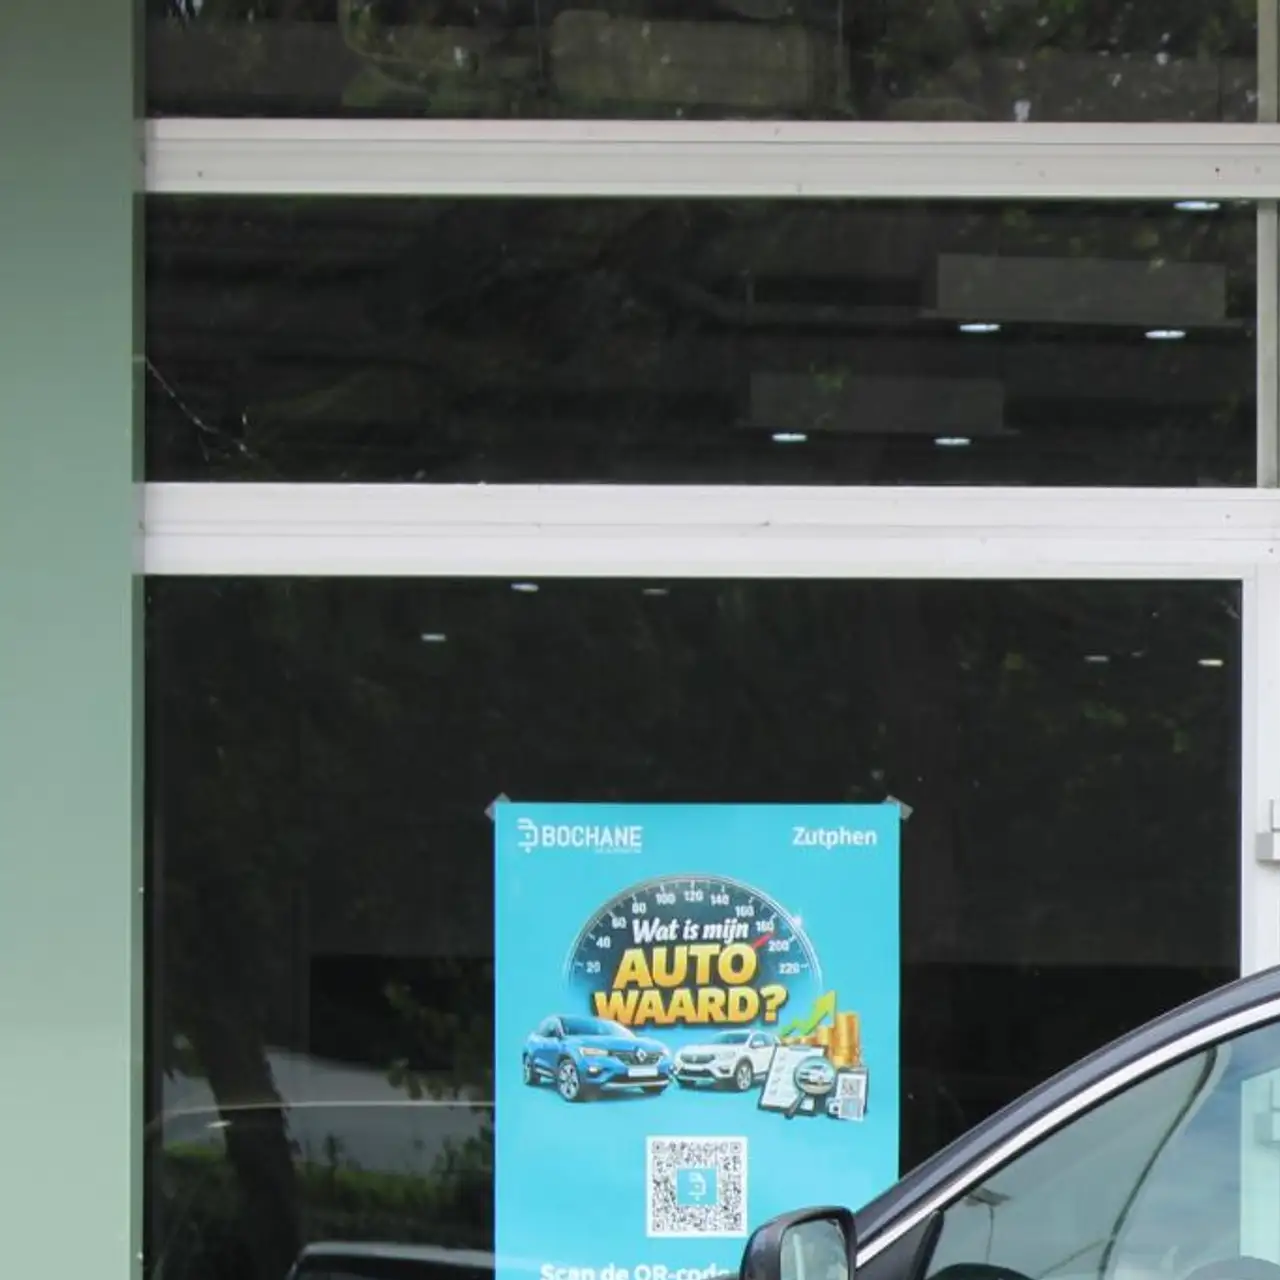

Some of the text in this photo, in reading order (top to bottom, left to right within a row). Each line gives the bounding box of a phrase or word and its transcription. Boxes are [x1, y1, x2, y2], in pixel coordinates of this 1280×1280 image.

[541, 825, 643, 848] BOCHANE
[792, 826, 878, 850] Zutphen
[655, 893, 676, 905] 100
[683, 890, 704, 902] 120
[710, 893, 730, 905] 140
[631, 917, 749, 944] Wat is mijn
[596, 936, 611, 948] 40
[768, 939, 790, 952] 200
[612, 943, 757, 989] AUTO
[594, 984, 788, 1025] WAARD?
